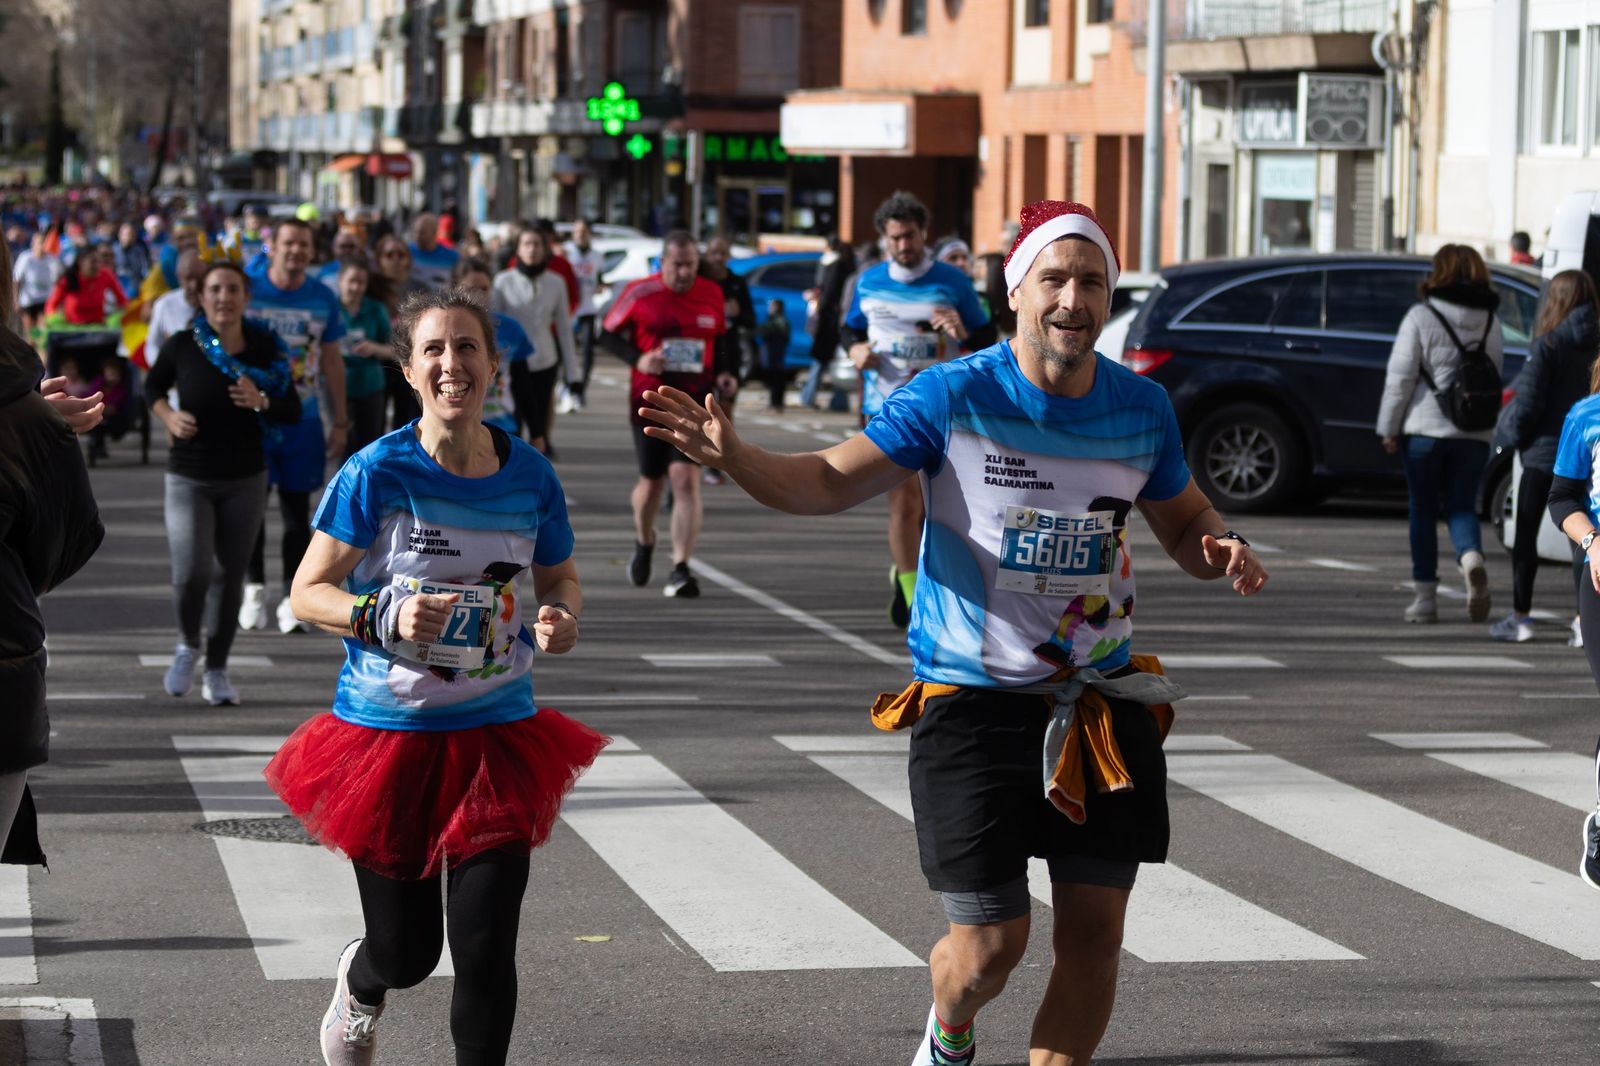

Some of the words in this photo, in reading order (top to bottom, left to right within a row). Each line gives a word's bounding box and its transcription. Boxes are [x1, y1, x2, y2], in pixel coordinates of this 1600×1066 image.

[663, 135, 826, 162] FRMAC
[984, 454, 1002, 465] XLI
[1004, 457, 1026, 467] SAN
[984, 465, 1038, 478] SILVESTRE
[984, 476, 1055, 490] SALMANTINA
[1037, 515, 1104, 531] SETEL
[409, 527, 422, 536] XLI
[424, 529, 441, 537] SAN
[408, 537, 450, 547] SILVESTRE
[408, 545, 461, 557] SALMANTINA
[1015, 531, 1092, 569] 5605
